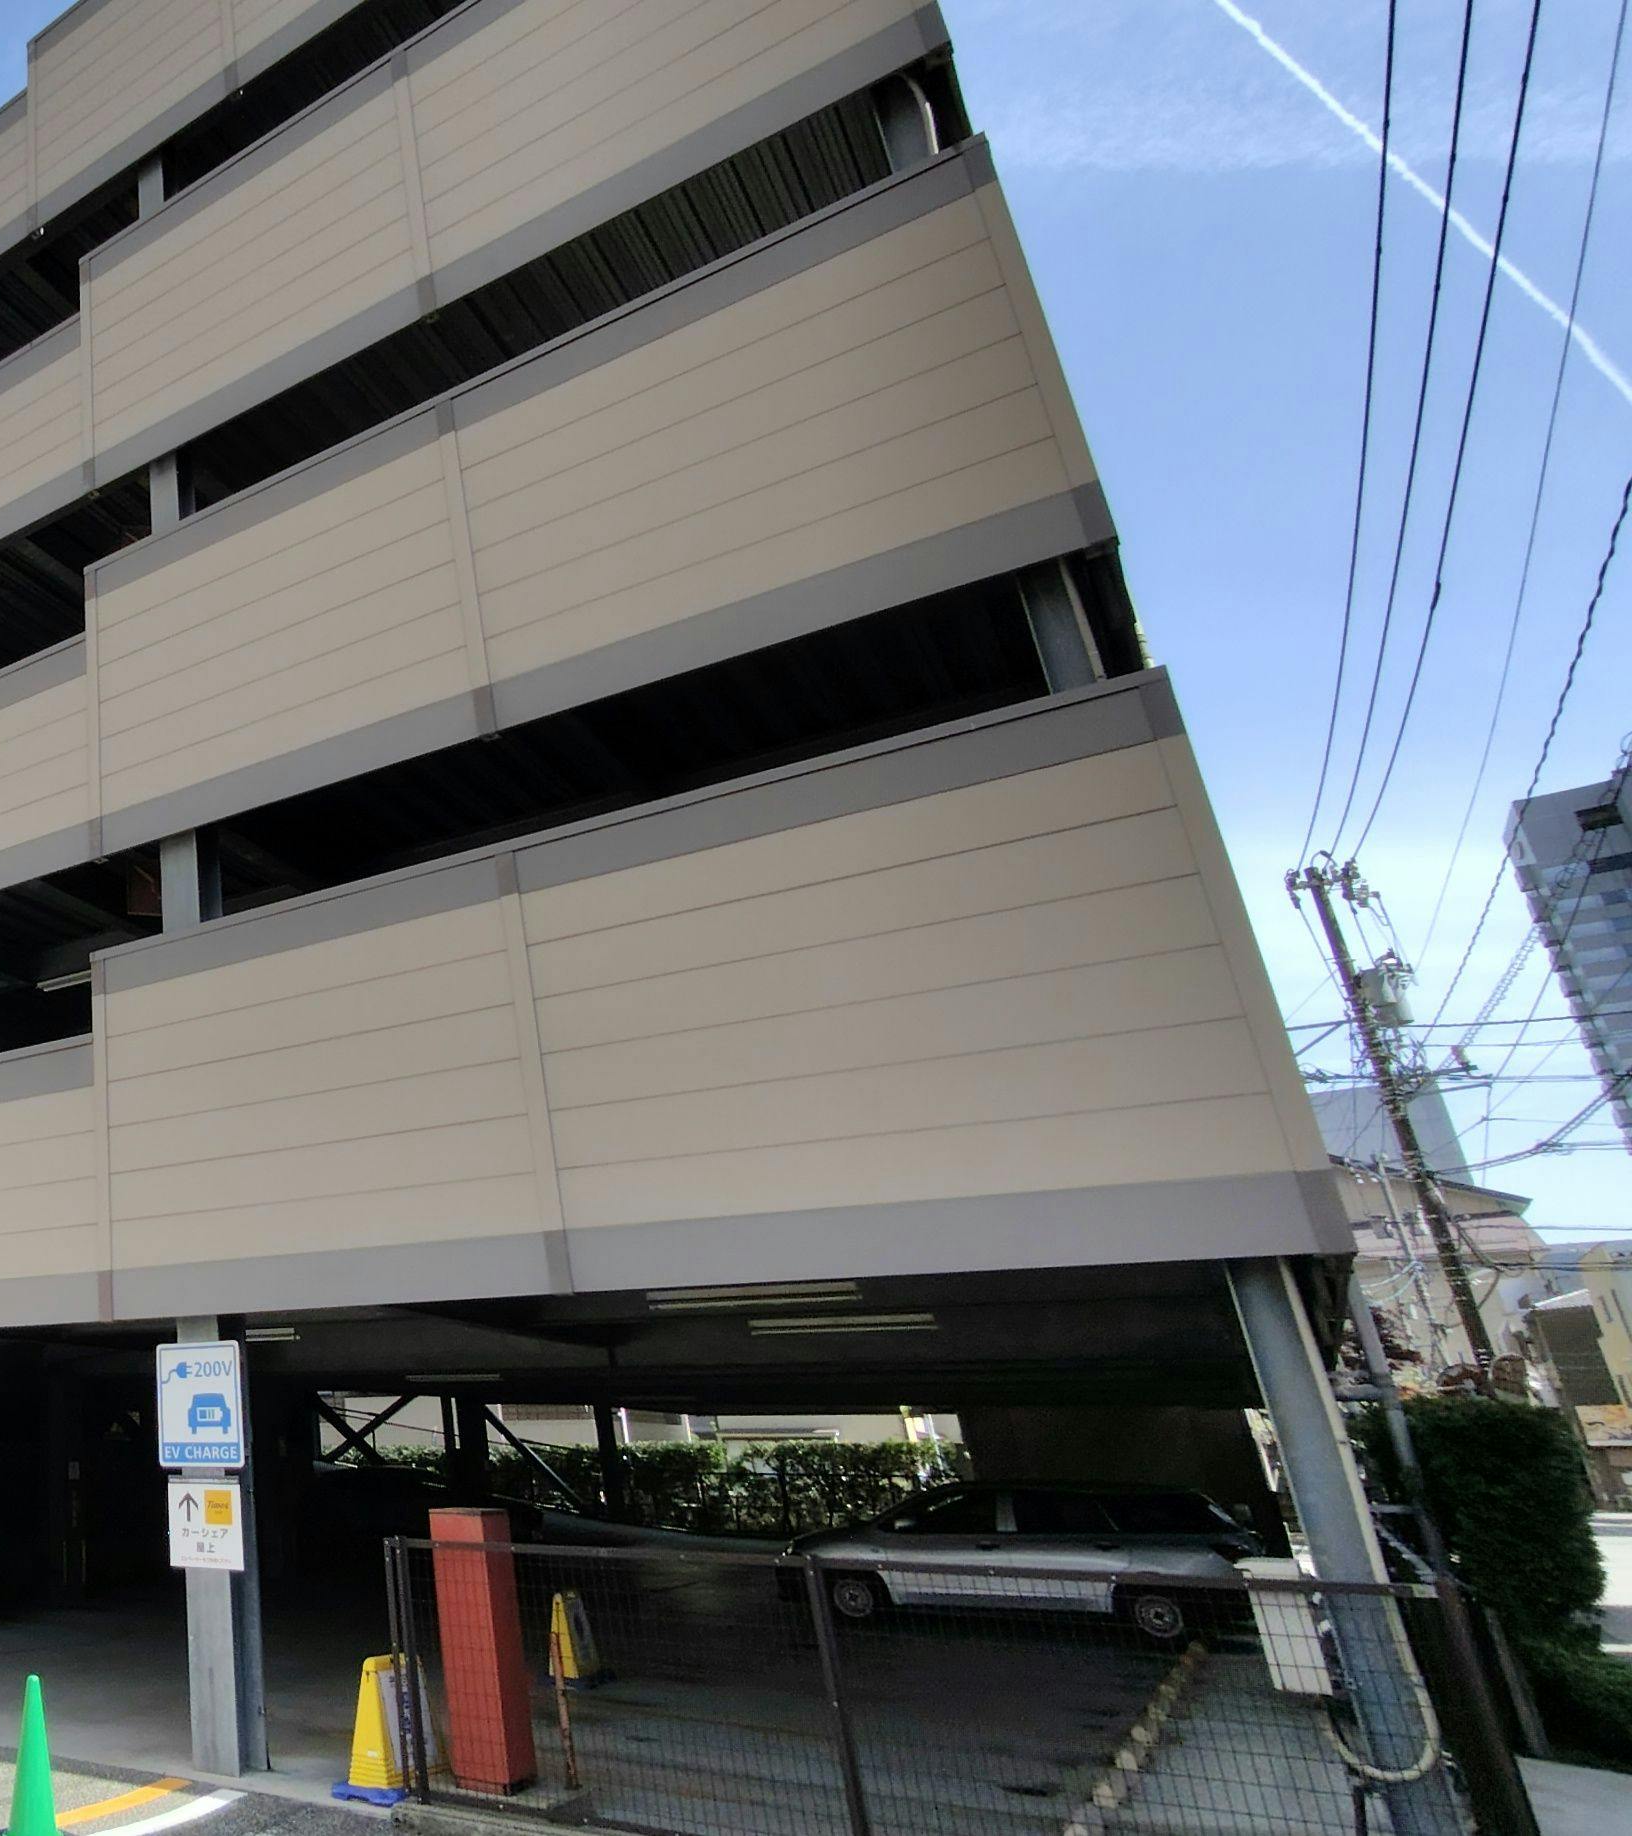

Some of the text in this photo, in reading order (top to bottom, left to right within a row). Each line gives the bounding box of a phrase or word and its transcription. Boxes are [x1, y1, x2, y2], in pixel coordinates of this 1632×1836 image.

[194, 1360, 233, 1377] 200V
[164, 1446, 238, 1459] EV CHARGE
[181, 1528, 229, 1539] カーシェア
